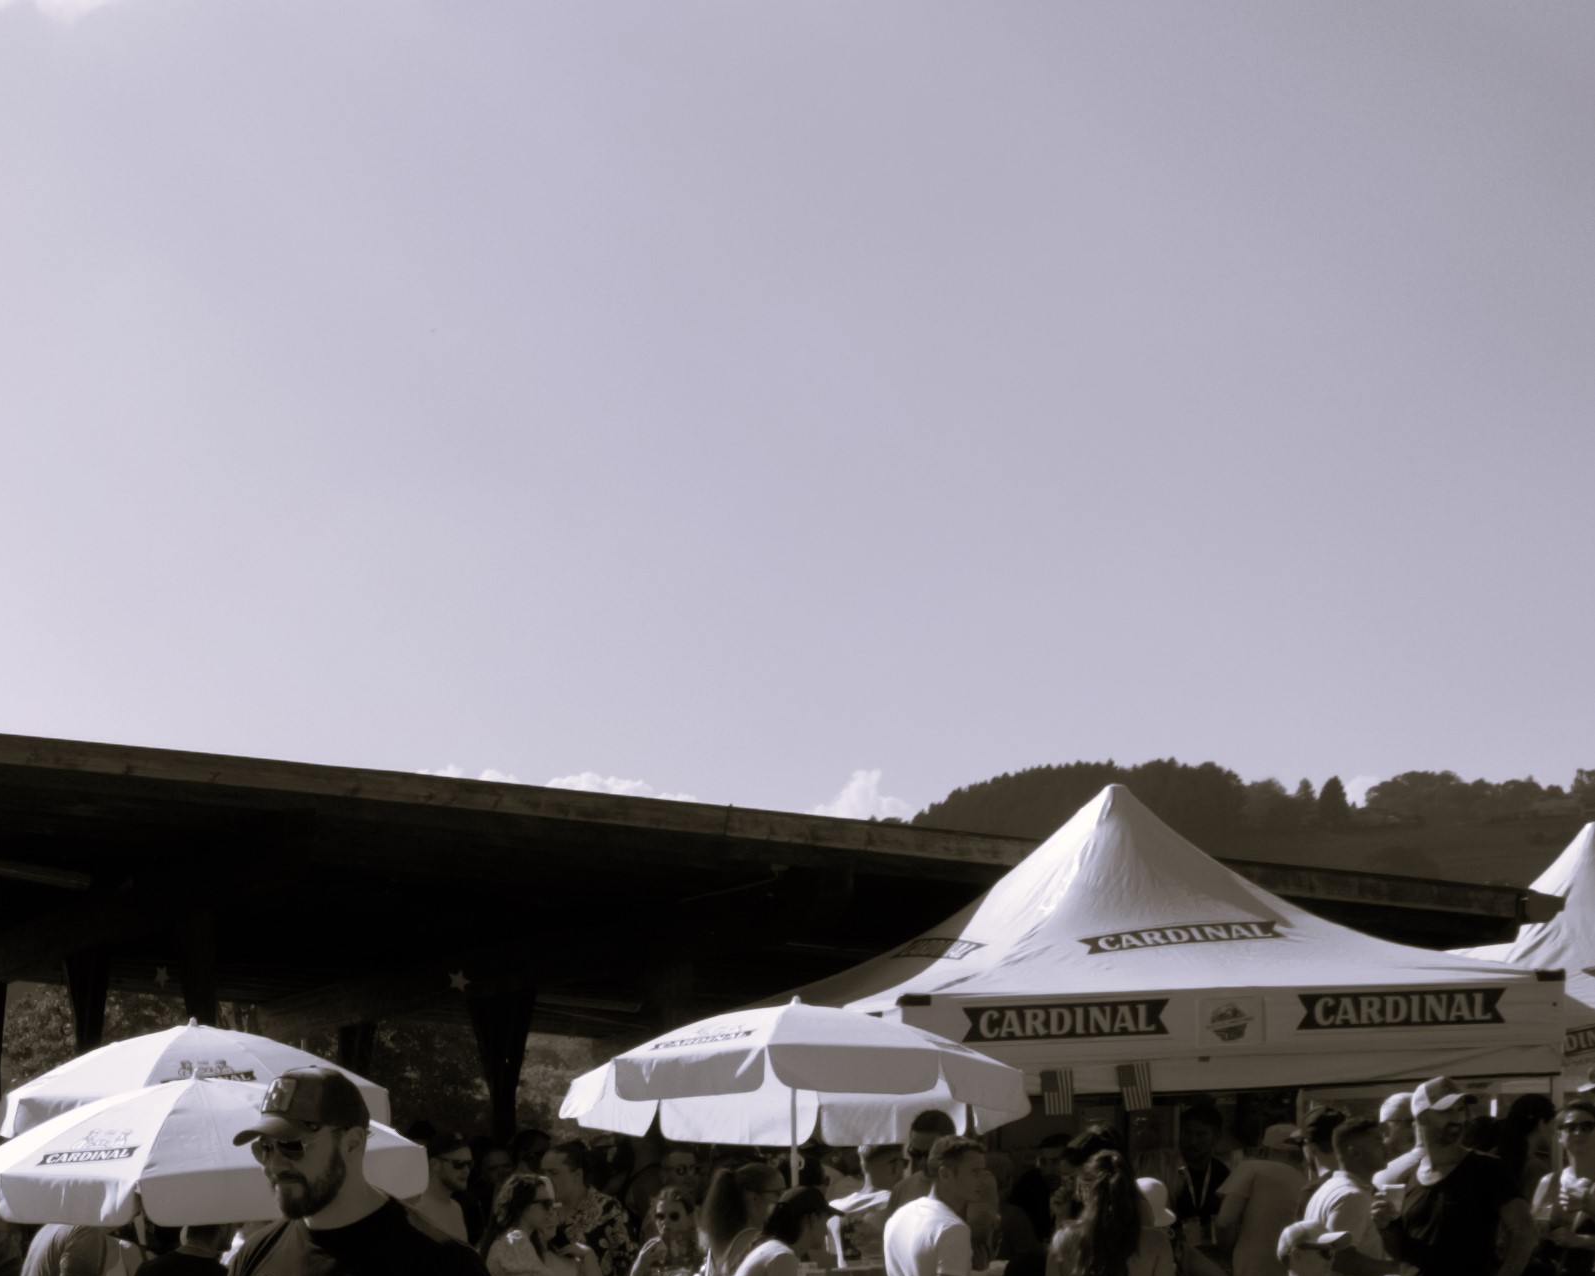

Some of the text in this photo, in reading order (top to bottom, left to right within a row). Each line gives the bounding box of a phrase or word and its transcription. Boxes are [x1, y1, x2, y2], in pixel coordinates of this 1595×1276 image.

[1097, 923, 1273, 951] CARDINAL
[979, 1003, 1157, 1039] CARDINAL
[1314, 991, 1494, 1027] CARDINAL
[45, 1147, 130, 1164] CARDINAL
